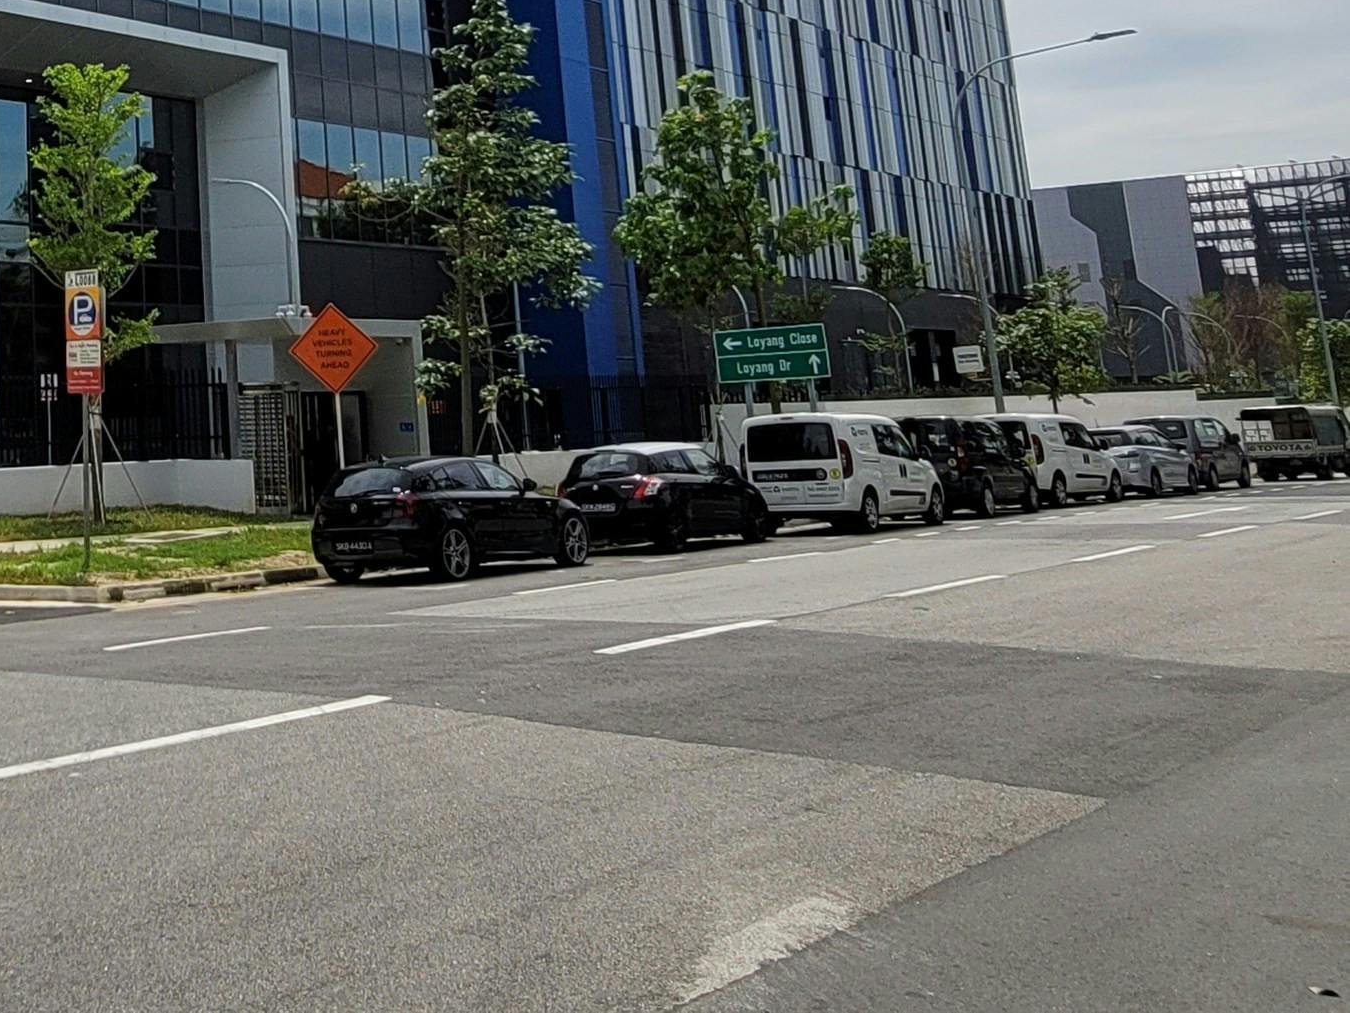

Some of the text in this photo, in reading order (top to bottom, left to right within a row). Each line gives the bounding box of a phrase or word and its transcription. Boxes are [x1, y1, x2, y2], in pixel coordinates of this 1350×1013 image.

[318, 328, 345, 337] HEAVY
[313, 337, 353, 347] VEHICLES
[746, 332, 818, 350] Loyang Close
[316, 349, 352, 358] TURNING
[321, 361, 350, 369] AHEAD
[736, 359, 792, 376] Loyang Dr
[1258, 444, 1306, 452] TOYOTA
